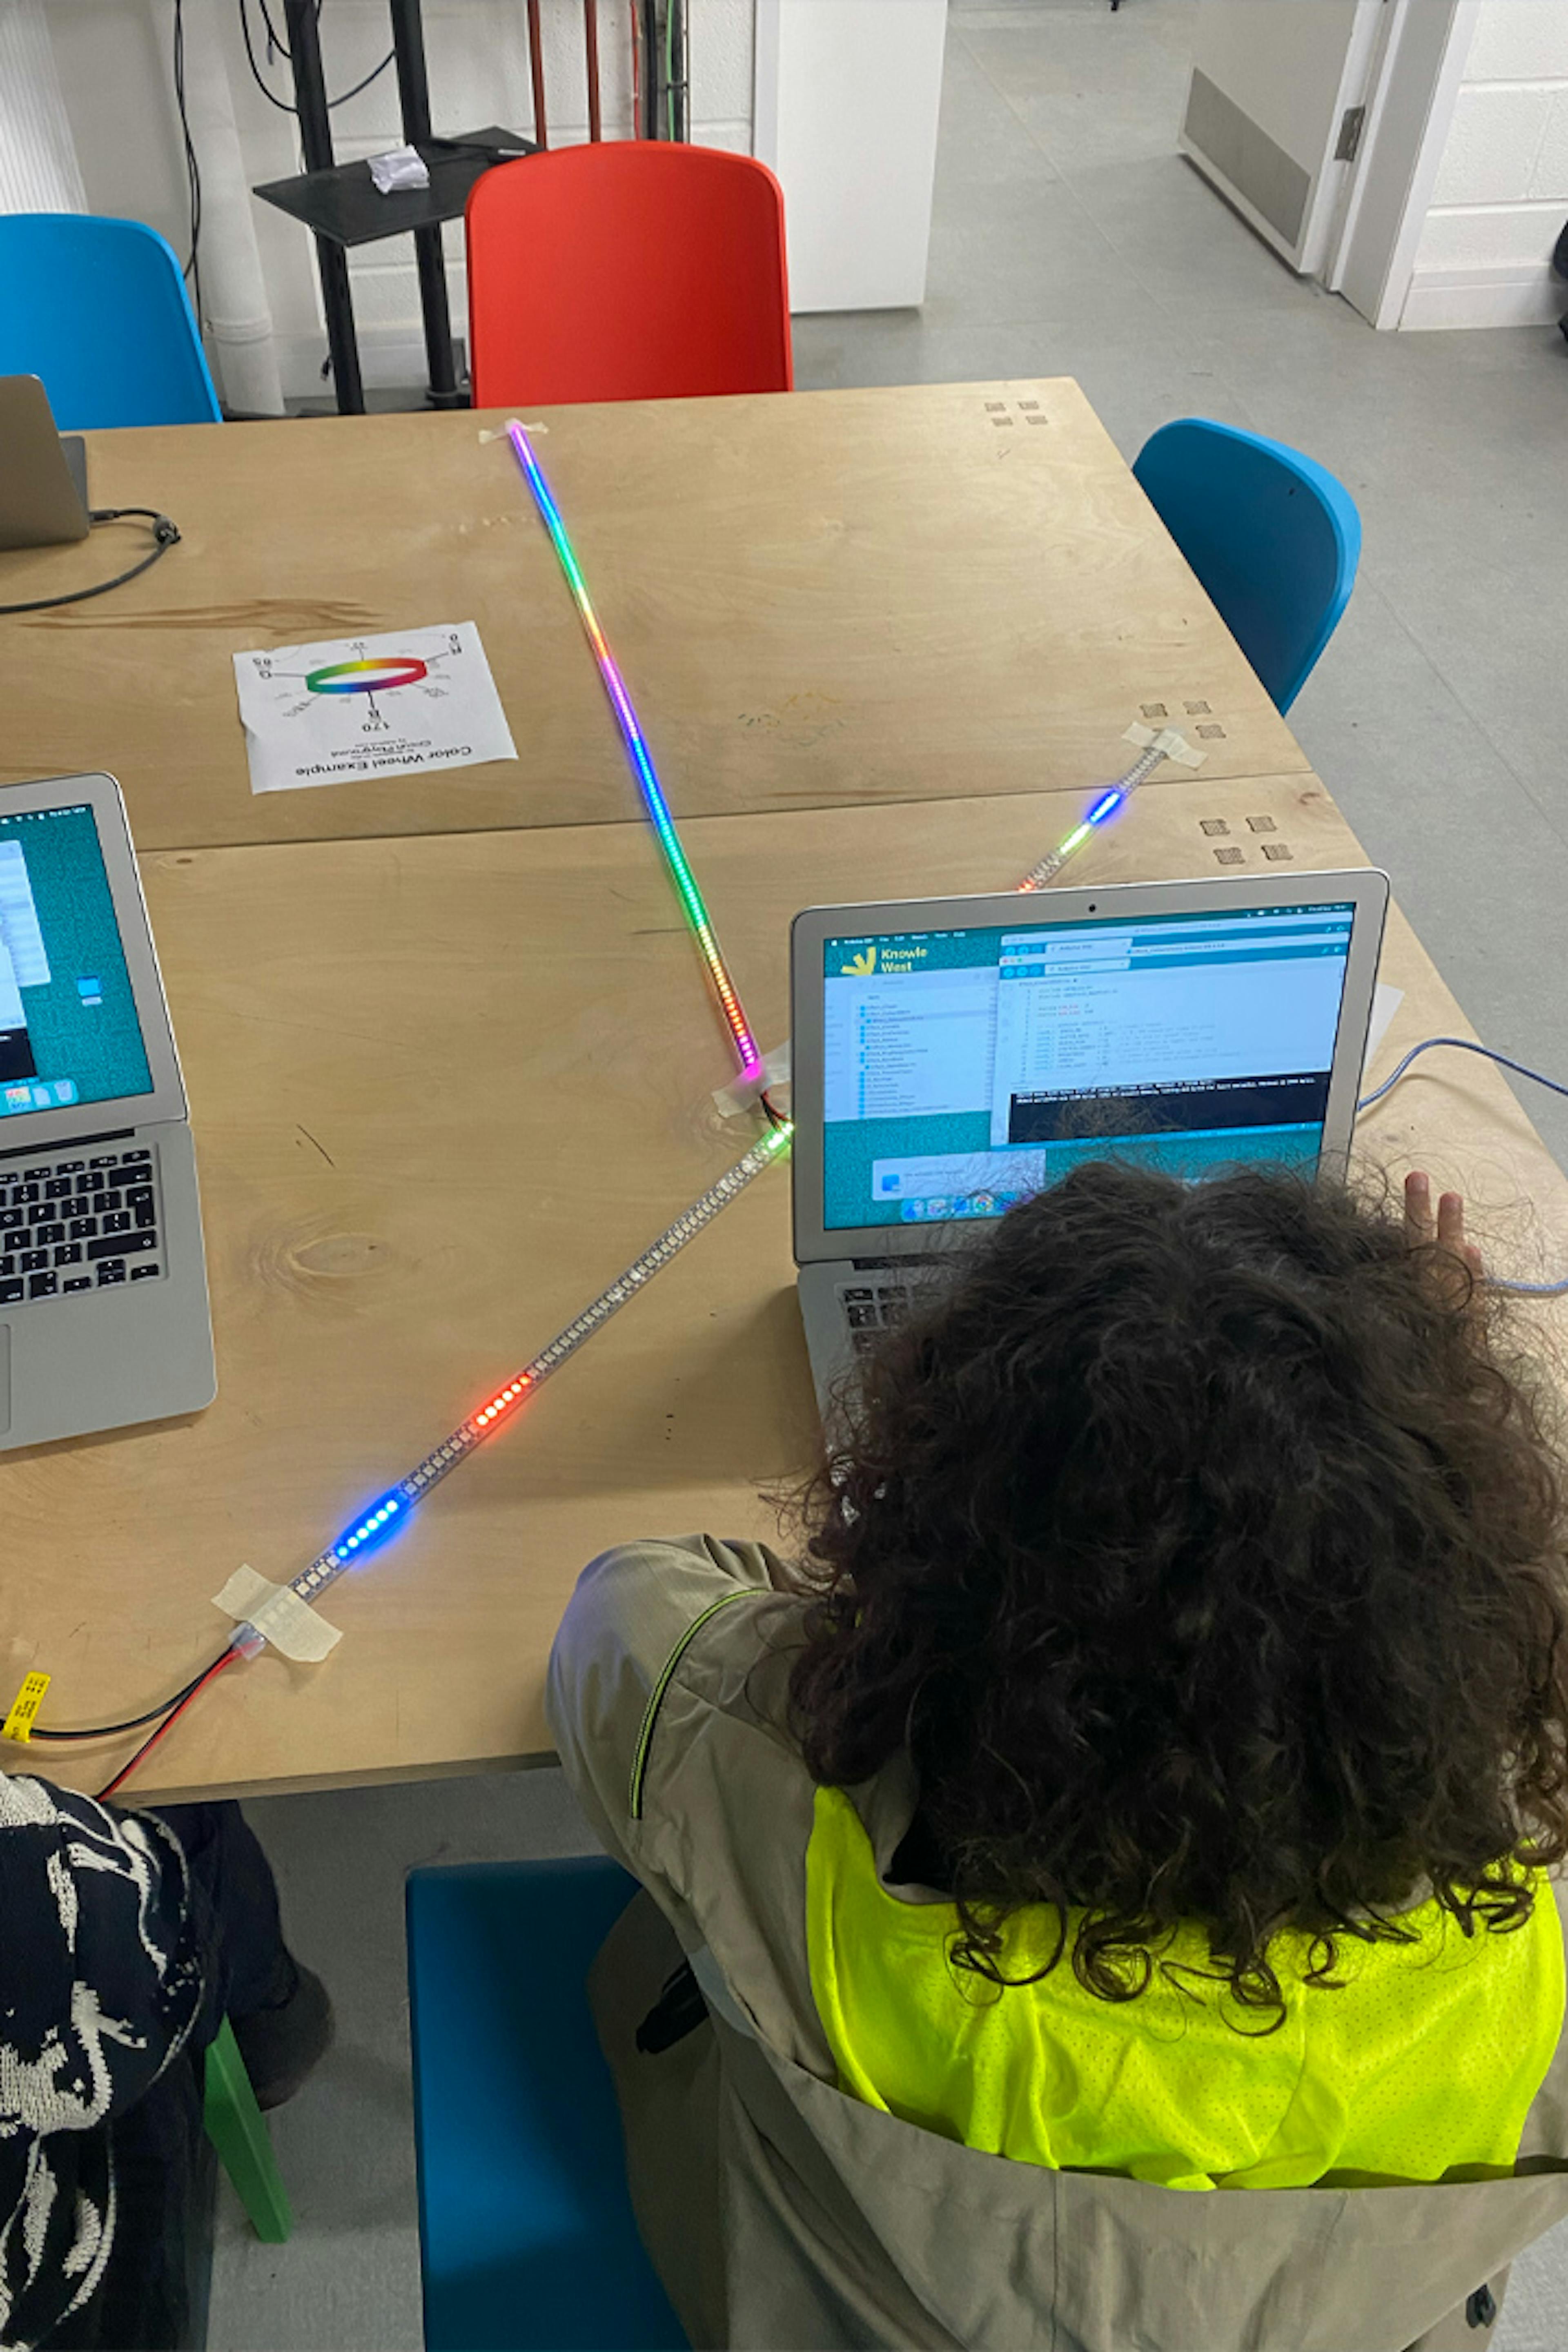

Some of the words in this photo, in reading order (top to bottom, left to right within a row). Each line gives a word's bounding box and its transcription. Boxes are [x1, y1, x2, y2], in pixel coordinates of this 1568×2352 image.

[362, 722, 390, 732] 170
[428, 746, 472, 759] Color
[372, 753, 425, 768] Wheel
[296, 761, 369, 776] Example
[881, 947, 928, 959] Knowle
[881, 962, 912, 973] West
